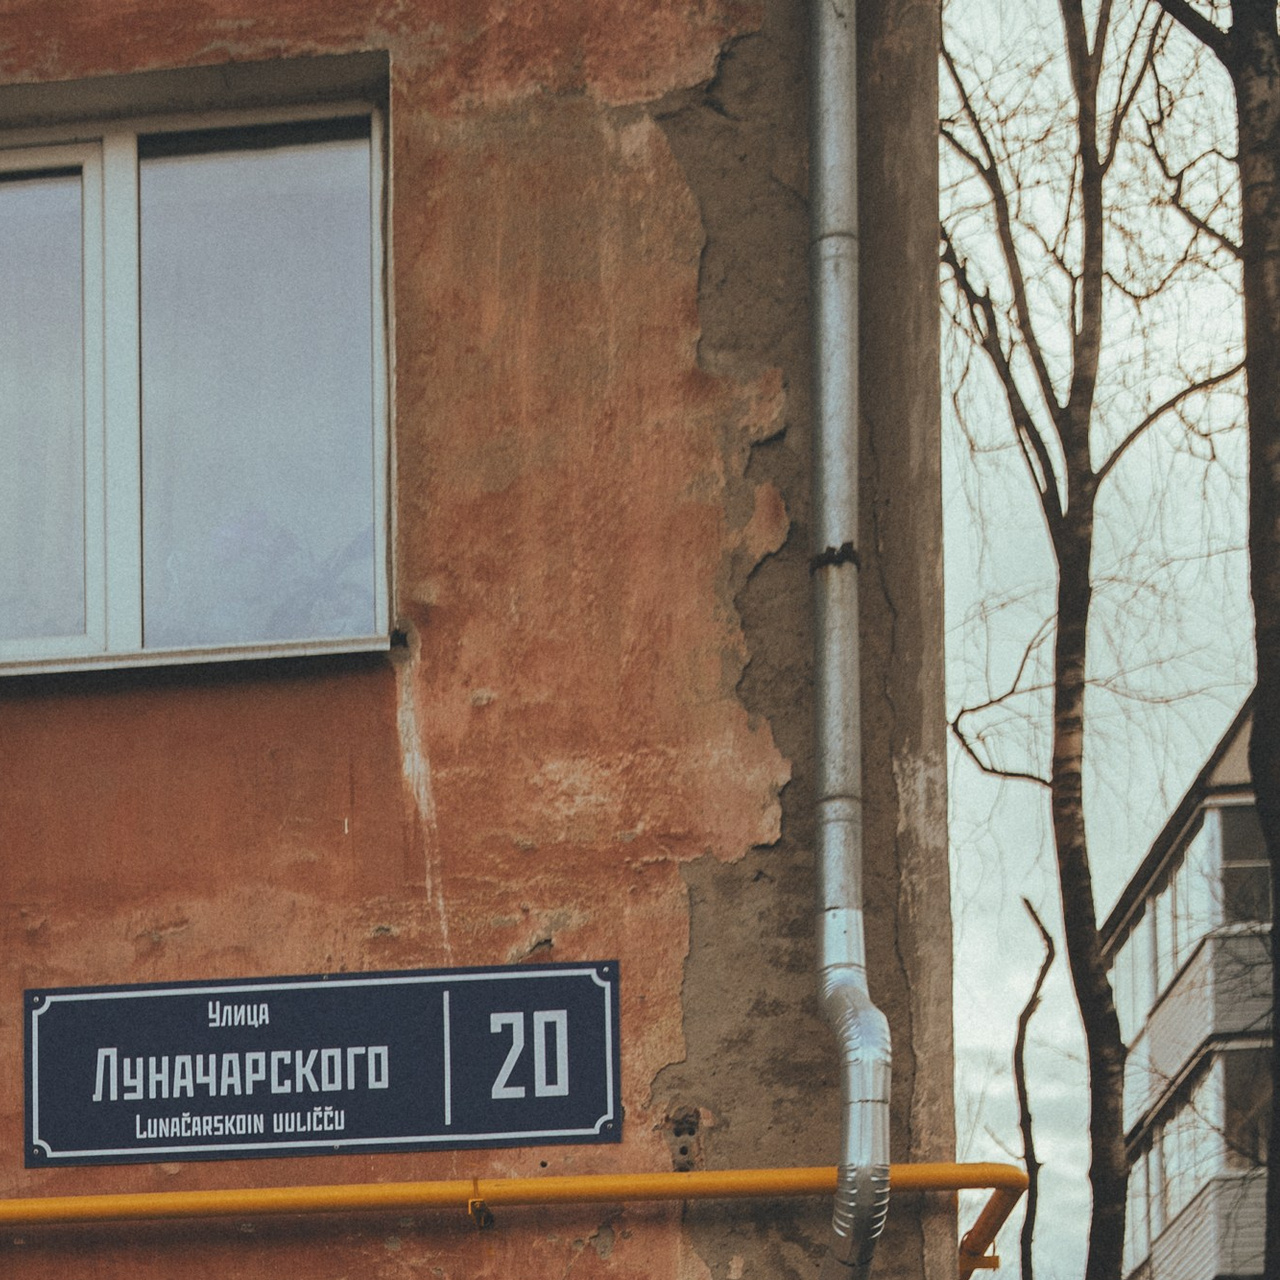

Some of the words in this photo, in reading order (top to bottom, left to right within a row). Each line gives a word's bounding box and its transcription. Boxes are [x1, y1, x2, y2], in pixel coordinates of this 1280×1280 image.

[208, 1001, 270, 1029] Улица
[92, 1045, 389, 1102] Луначарского
[489, 1009, 570, 1100] 20
